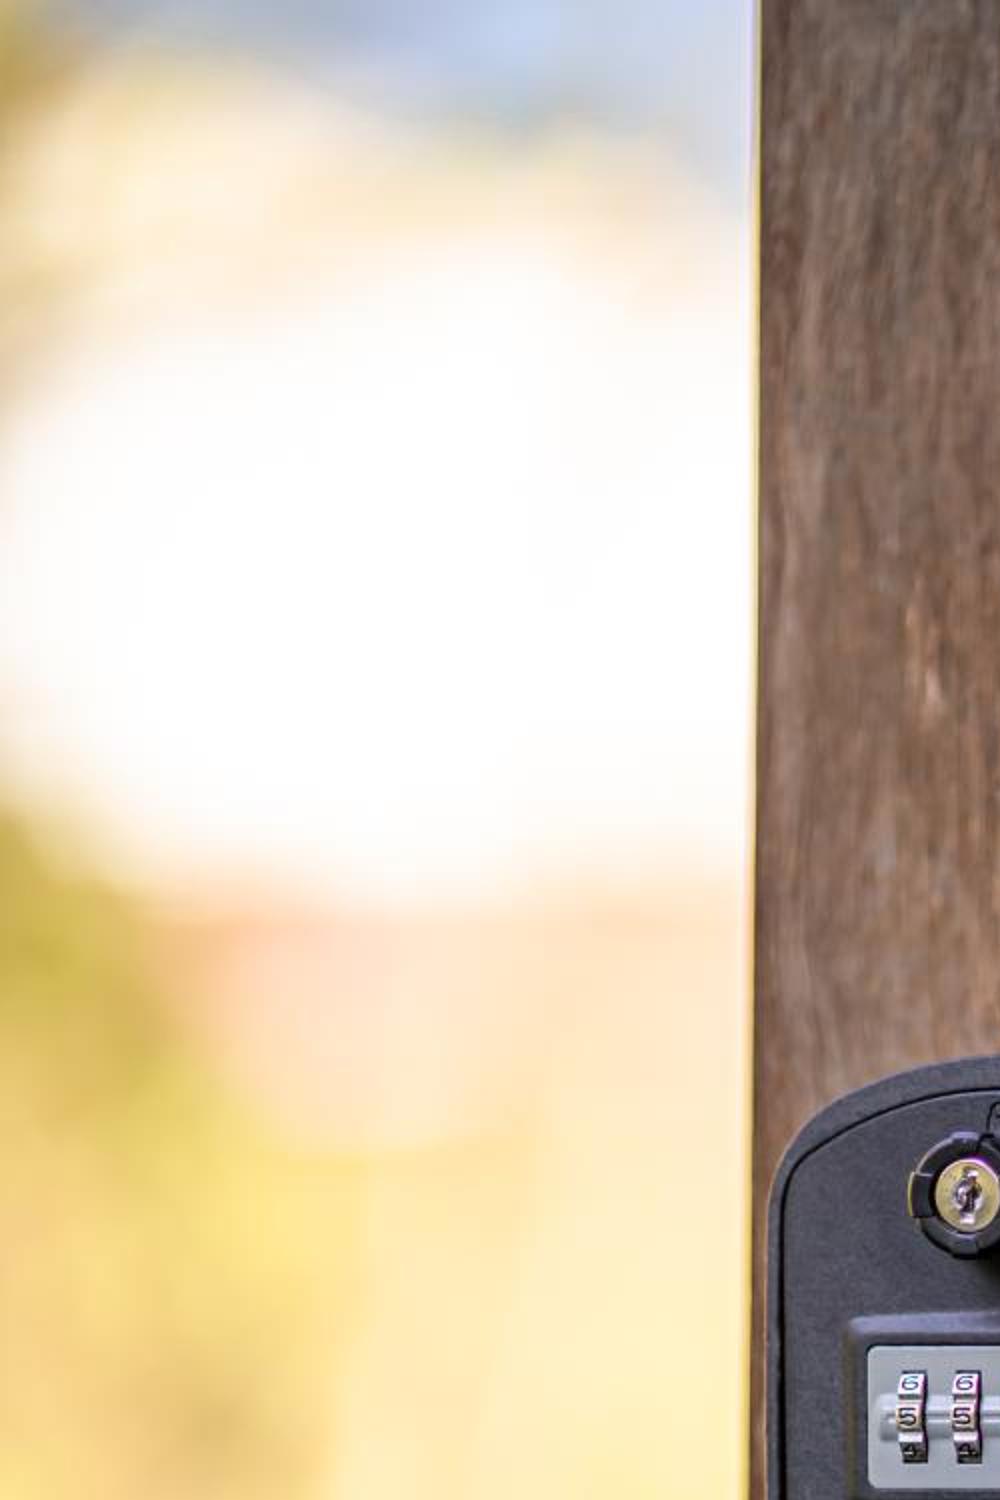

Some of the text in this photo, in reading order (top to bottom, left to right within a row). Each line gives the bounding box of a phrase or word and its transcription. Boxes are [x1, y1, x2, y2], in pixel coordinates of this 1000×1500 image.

[902, 1376, 919, 1390] 6
[956, 1376, 973, 1390] 6
[899, 1408, 917, 1425] 5
[953, 1408, 971, 1425] 5
